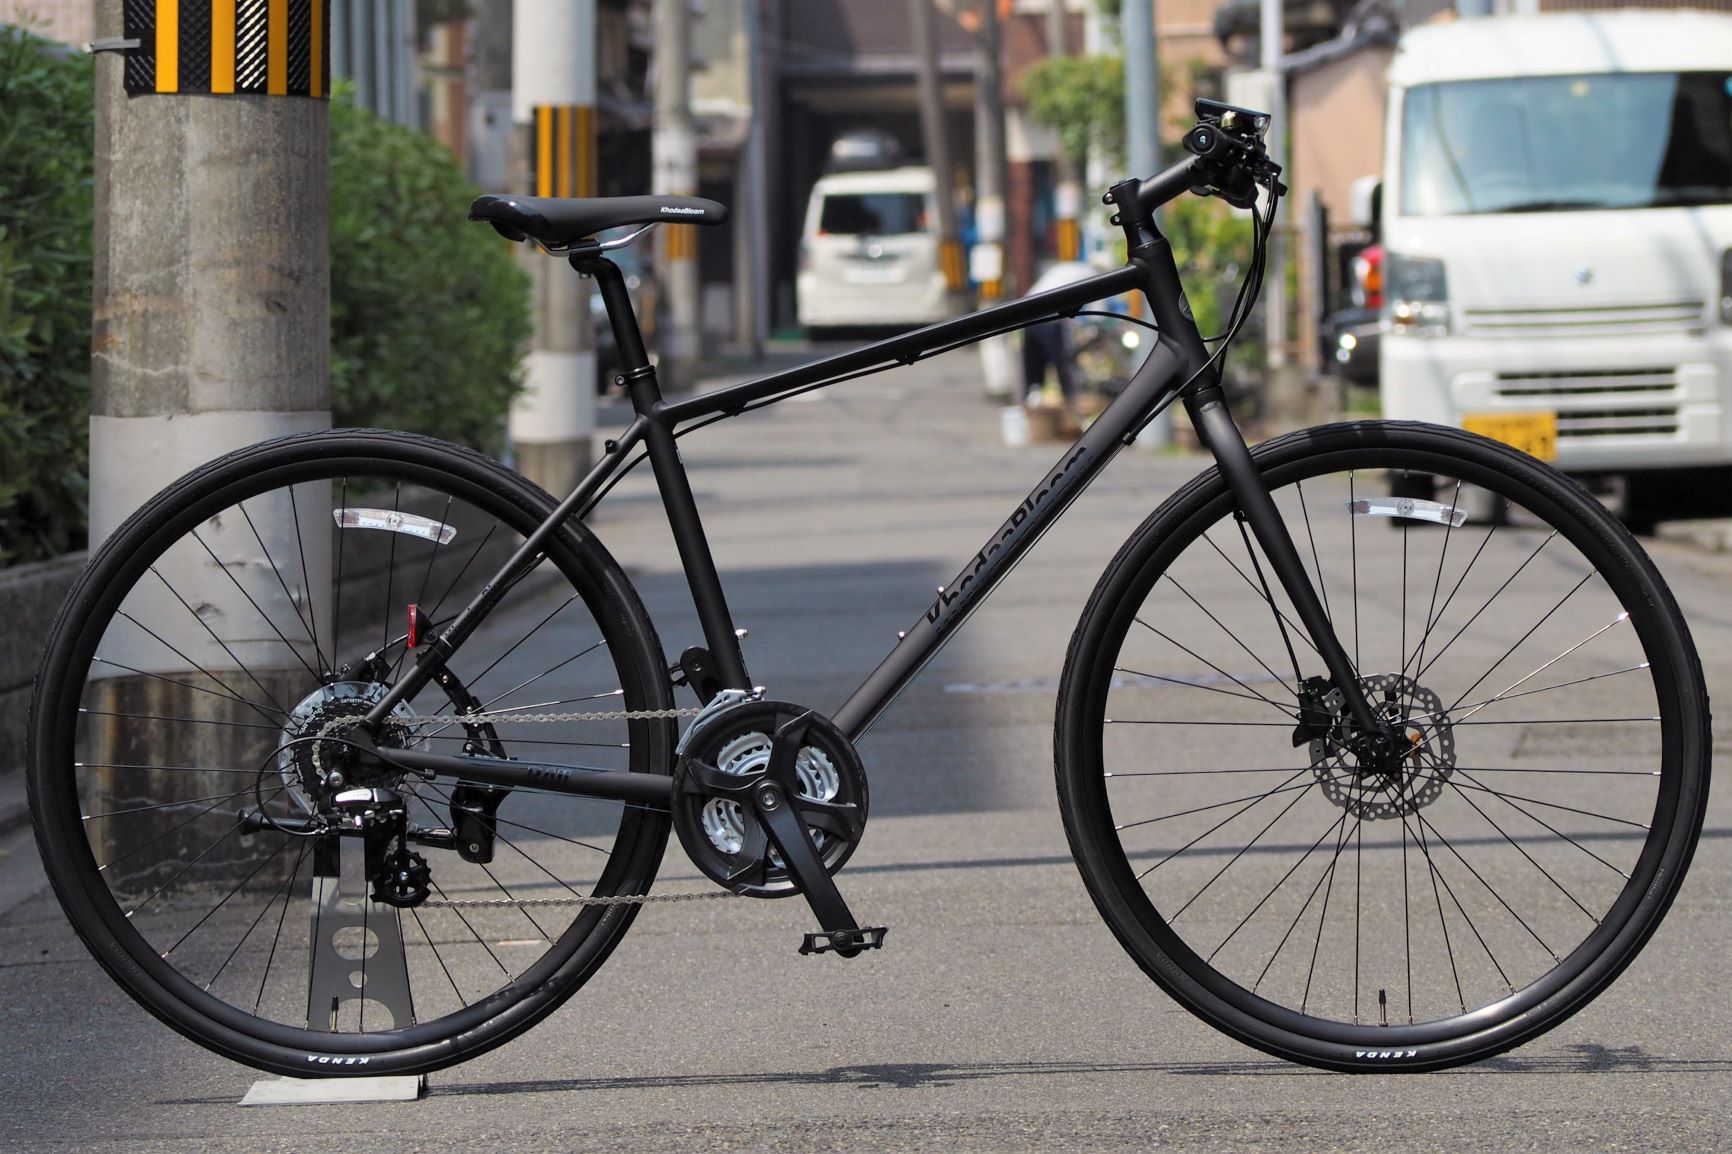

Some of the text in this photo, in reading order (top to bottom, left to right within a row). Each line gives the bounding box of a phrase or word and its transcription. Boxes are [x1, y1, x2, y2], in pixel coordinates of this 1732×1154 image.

[660, 206, 705, 215] KhodaaBloom
[1355, 1049, 1417, 1059] KENDA
[307, 1055, 370, 1065] KENDA
